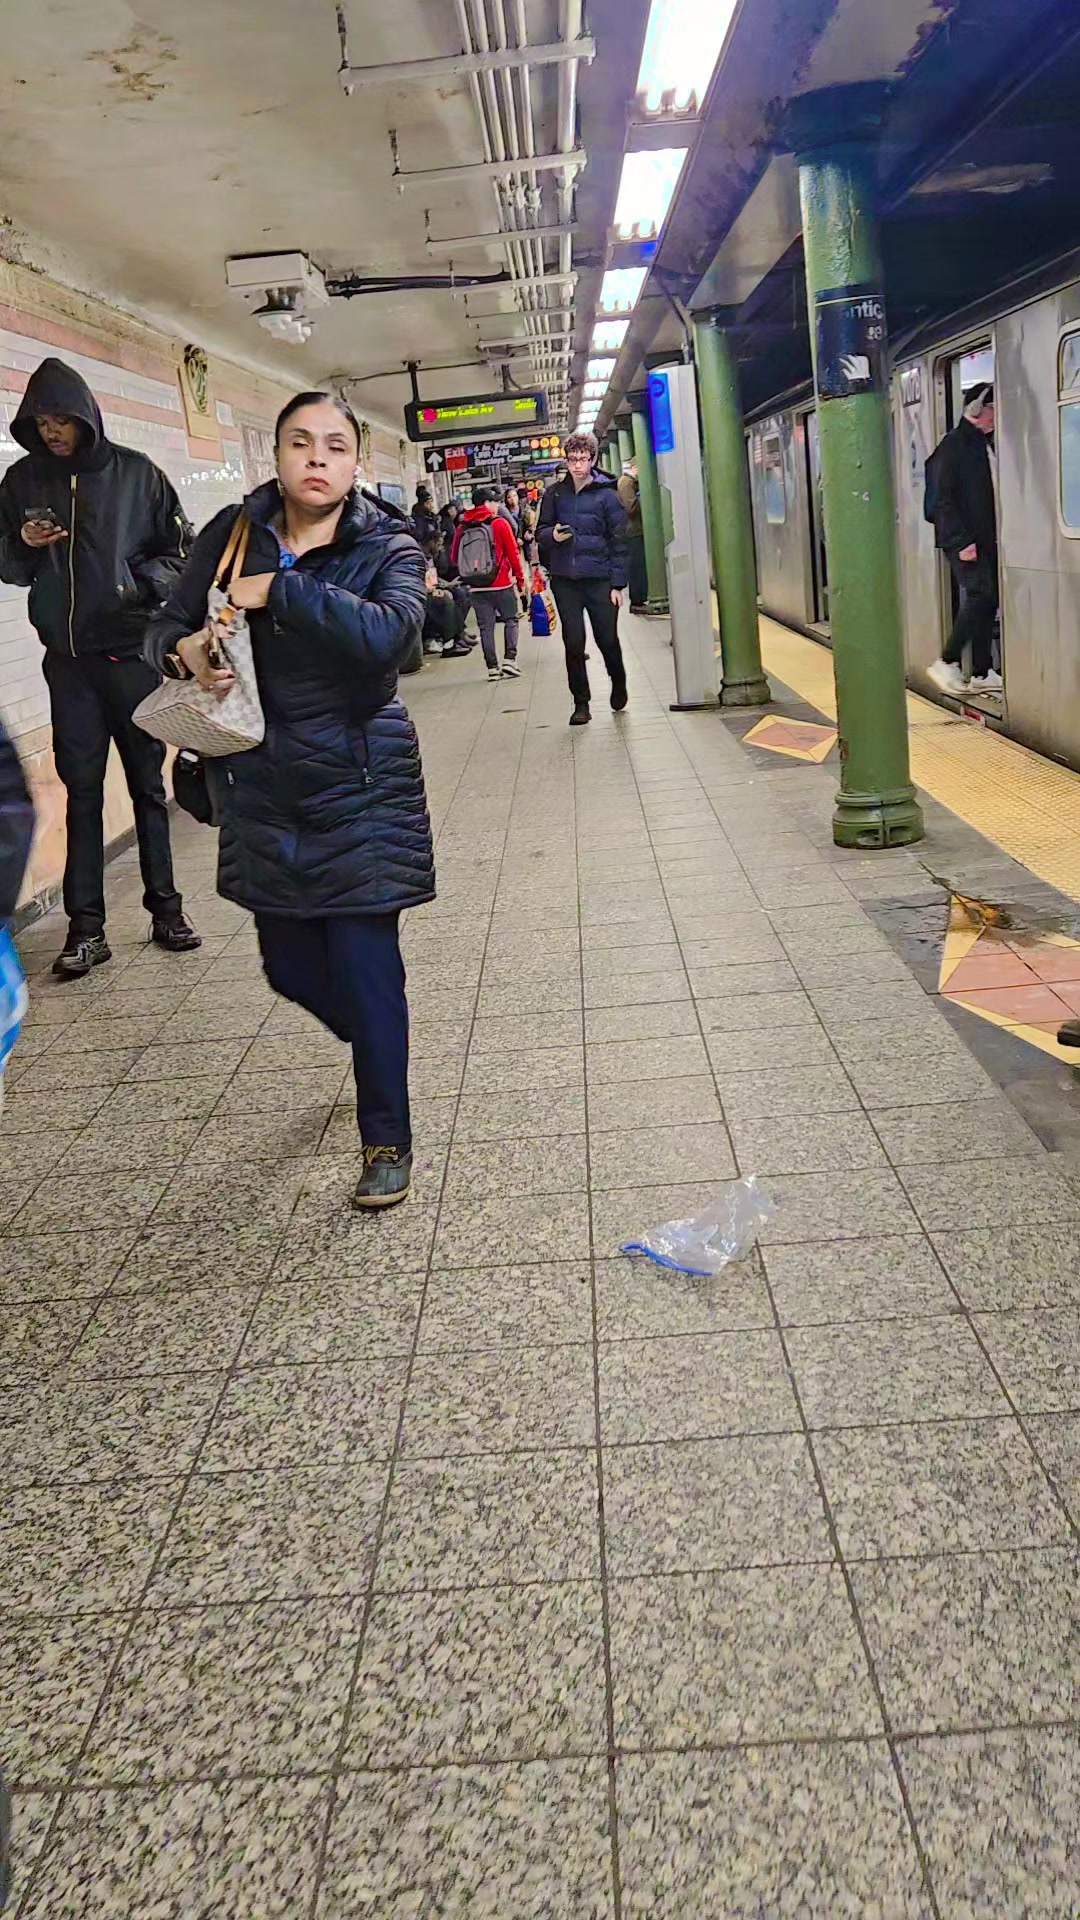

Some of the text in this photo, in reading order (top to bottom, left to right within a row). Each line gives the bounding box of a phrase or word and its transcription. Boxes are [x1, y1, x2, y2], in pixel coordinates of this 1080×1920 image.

[494, 441, 519, 450] Pacific
[444, 446, 466, 457] Exit
[492, 448, 510, 457] BAM
[474, 457, 504, 466] Barclays
